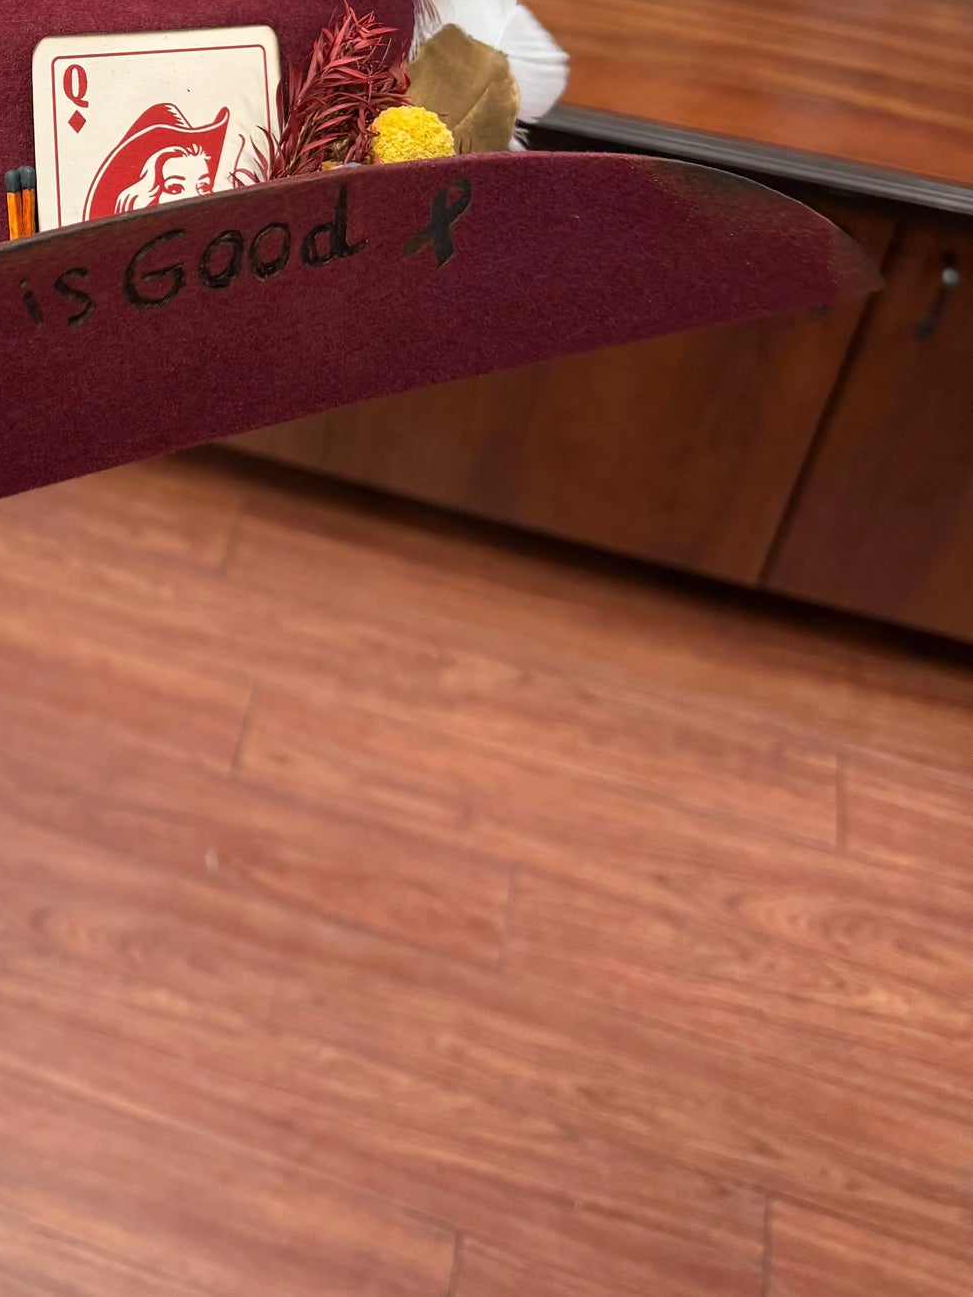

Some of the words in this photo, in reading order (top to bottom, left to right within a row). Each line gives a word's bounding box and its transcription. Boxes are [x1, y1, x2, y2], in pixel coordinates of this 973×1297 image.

[63, 64, 89, 108] Q
[19, 266, 97, 327] is
[123, 183, 369, 310] Good
